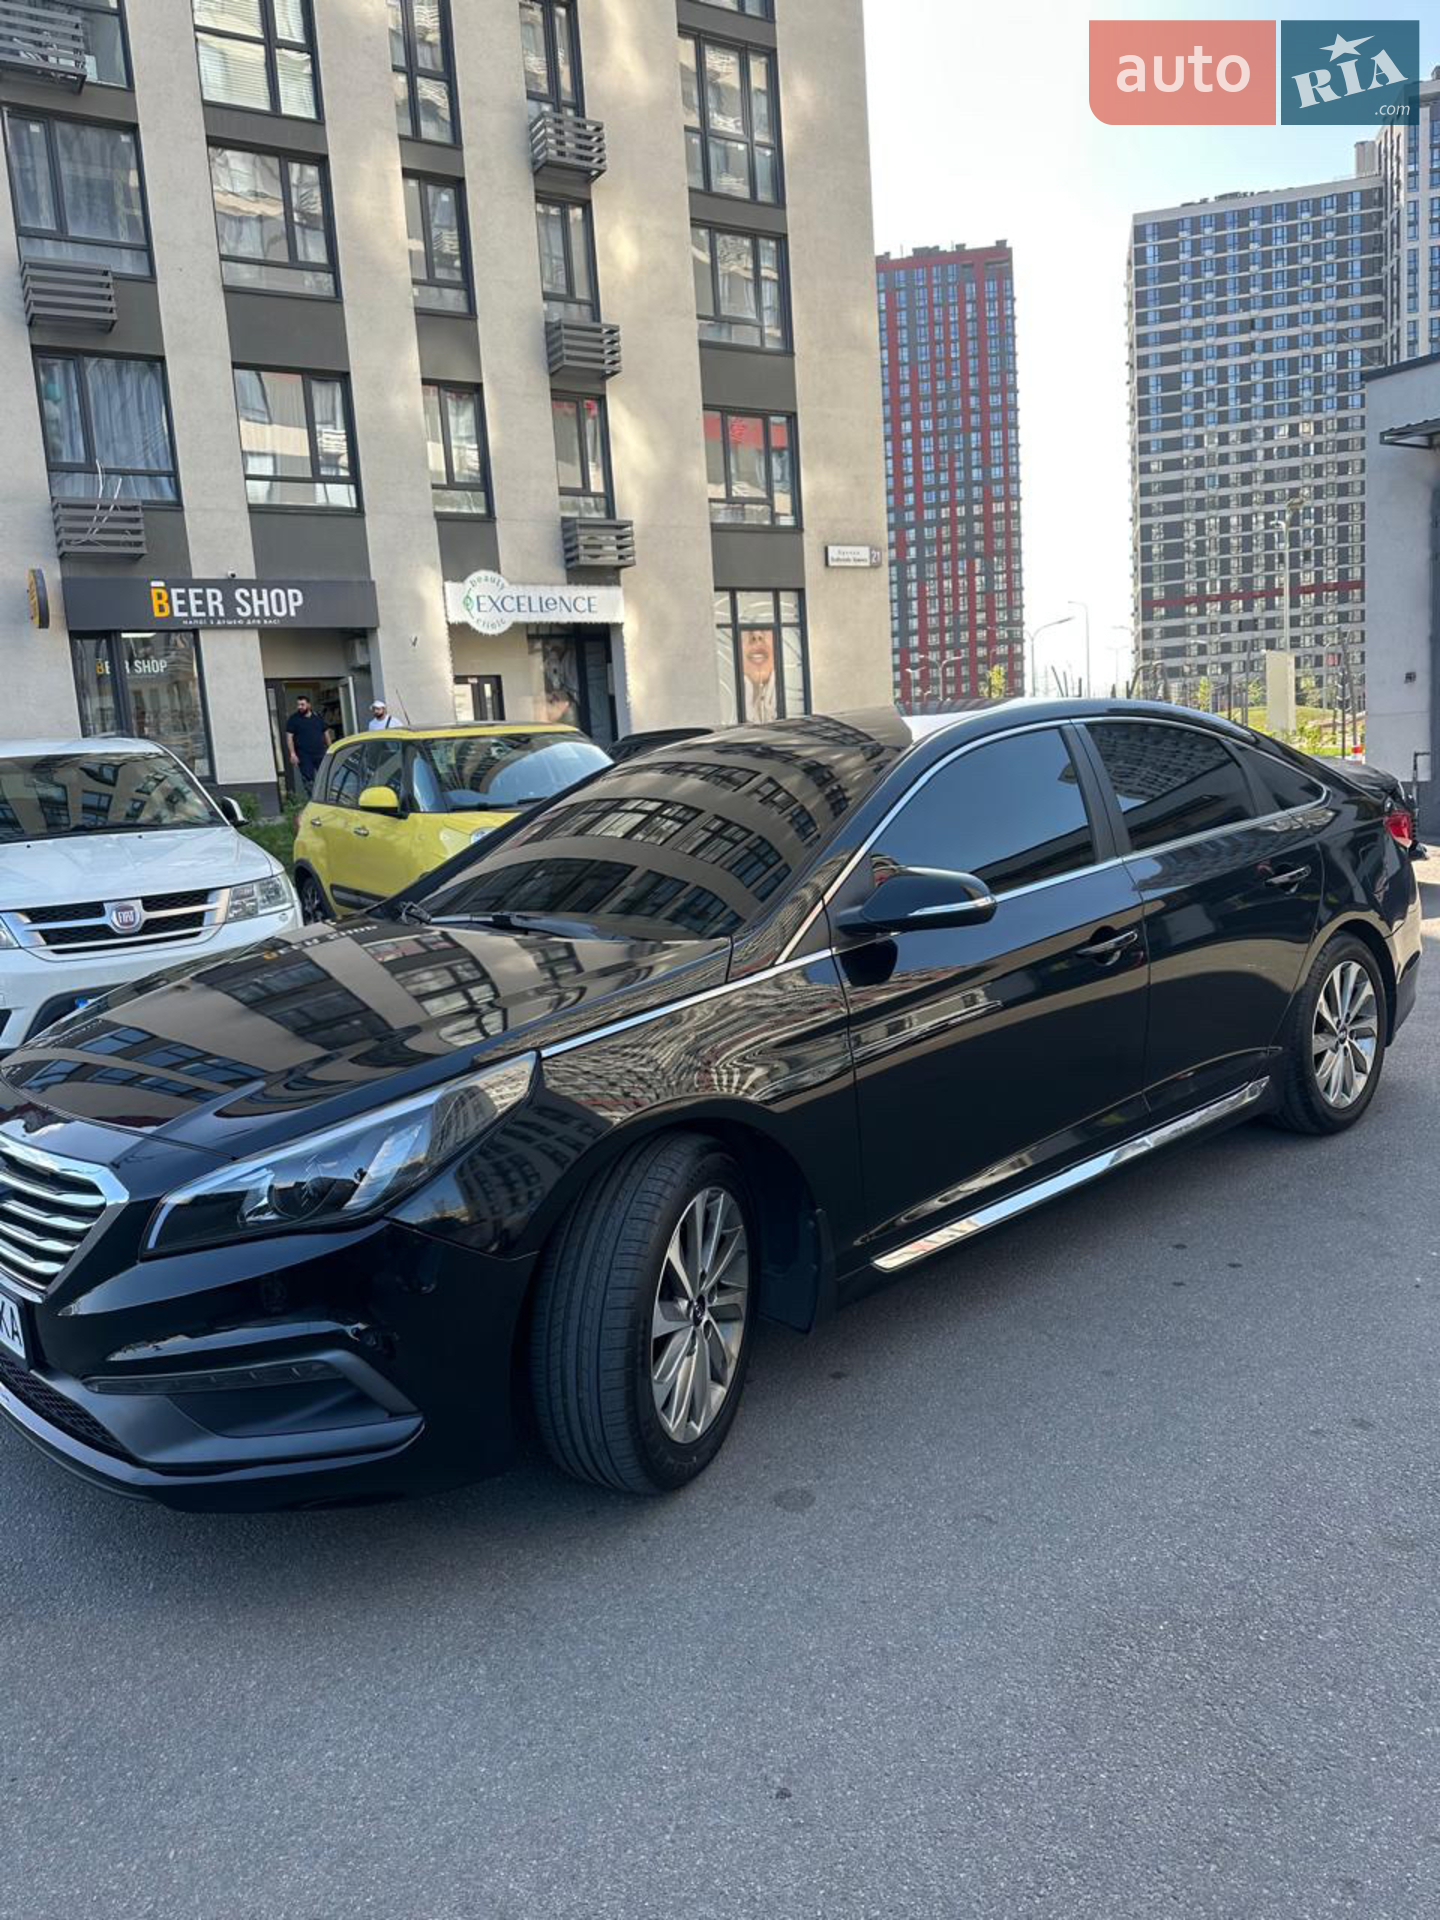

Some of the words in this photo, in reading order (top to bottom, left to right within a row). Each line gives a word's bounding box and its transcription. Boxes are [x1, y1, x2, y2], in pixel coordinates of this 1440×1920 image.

[151, 585, 225, 618] BEER
[235, 587, 304, 617] SHOP
[134, 659, 167, 673] SHOP
